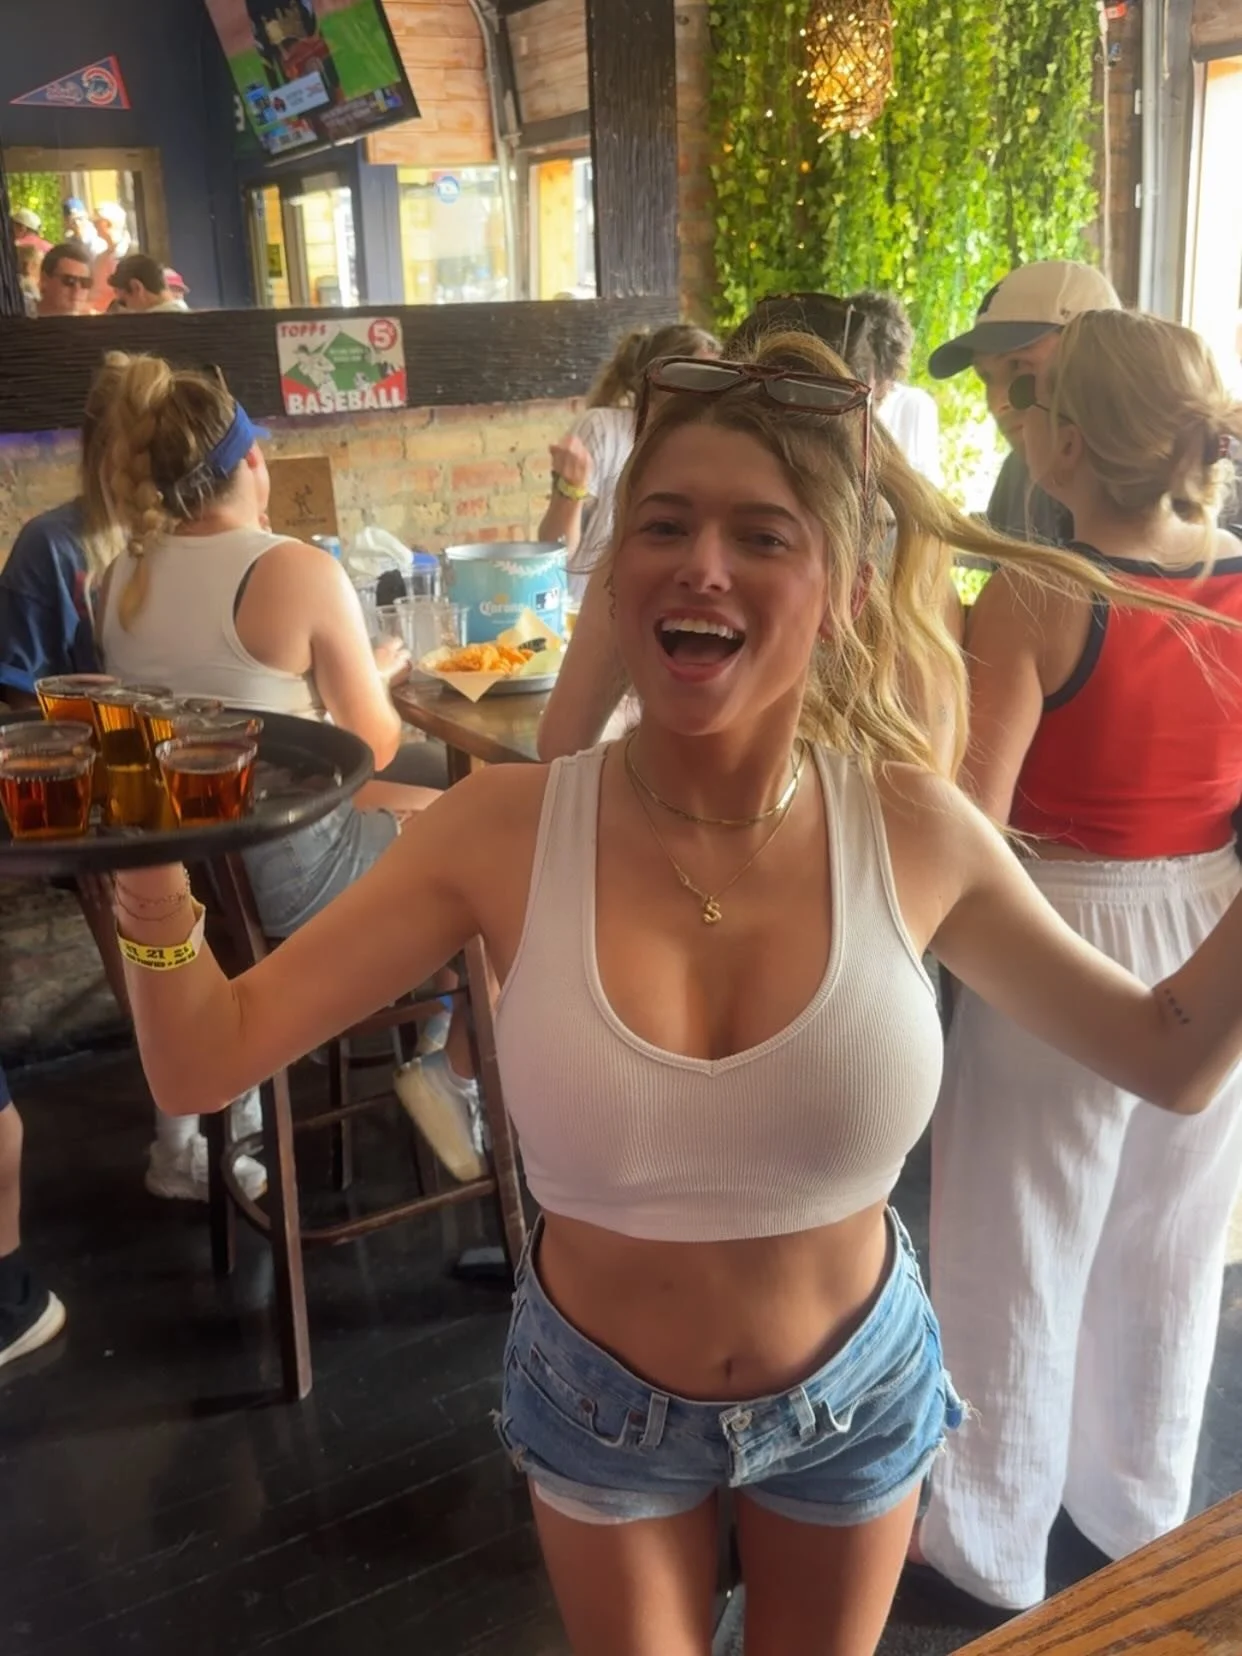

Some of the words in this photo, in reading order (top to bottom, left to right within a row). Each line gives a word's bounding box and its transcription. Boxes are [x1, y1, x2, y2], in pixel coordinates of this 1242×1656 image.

[280, 323, 326, 338] TOPPS
[288, 387, 405, 414] BASEBALL
[146, 949, 166, 960] 21
